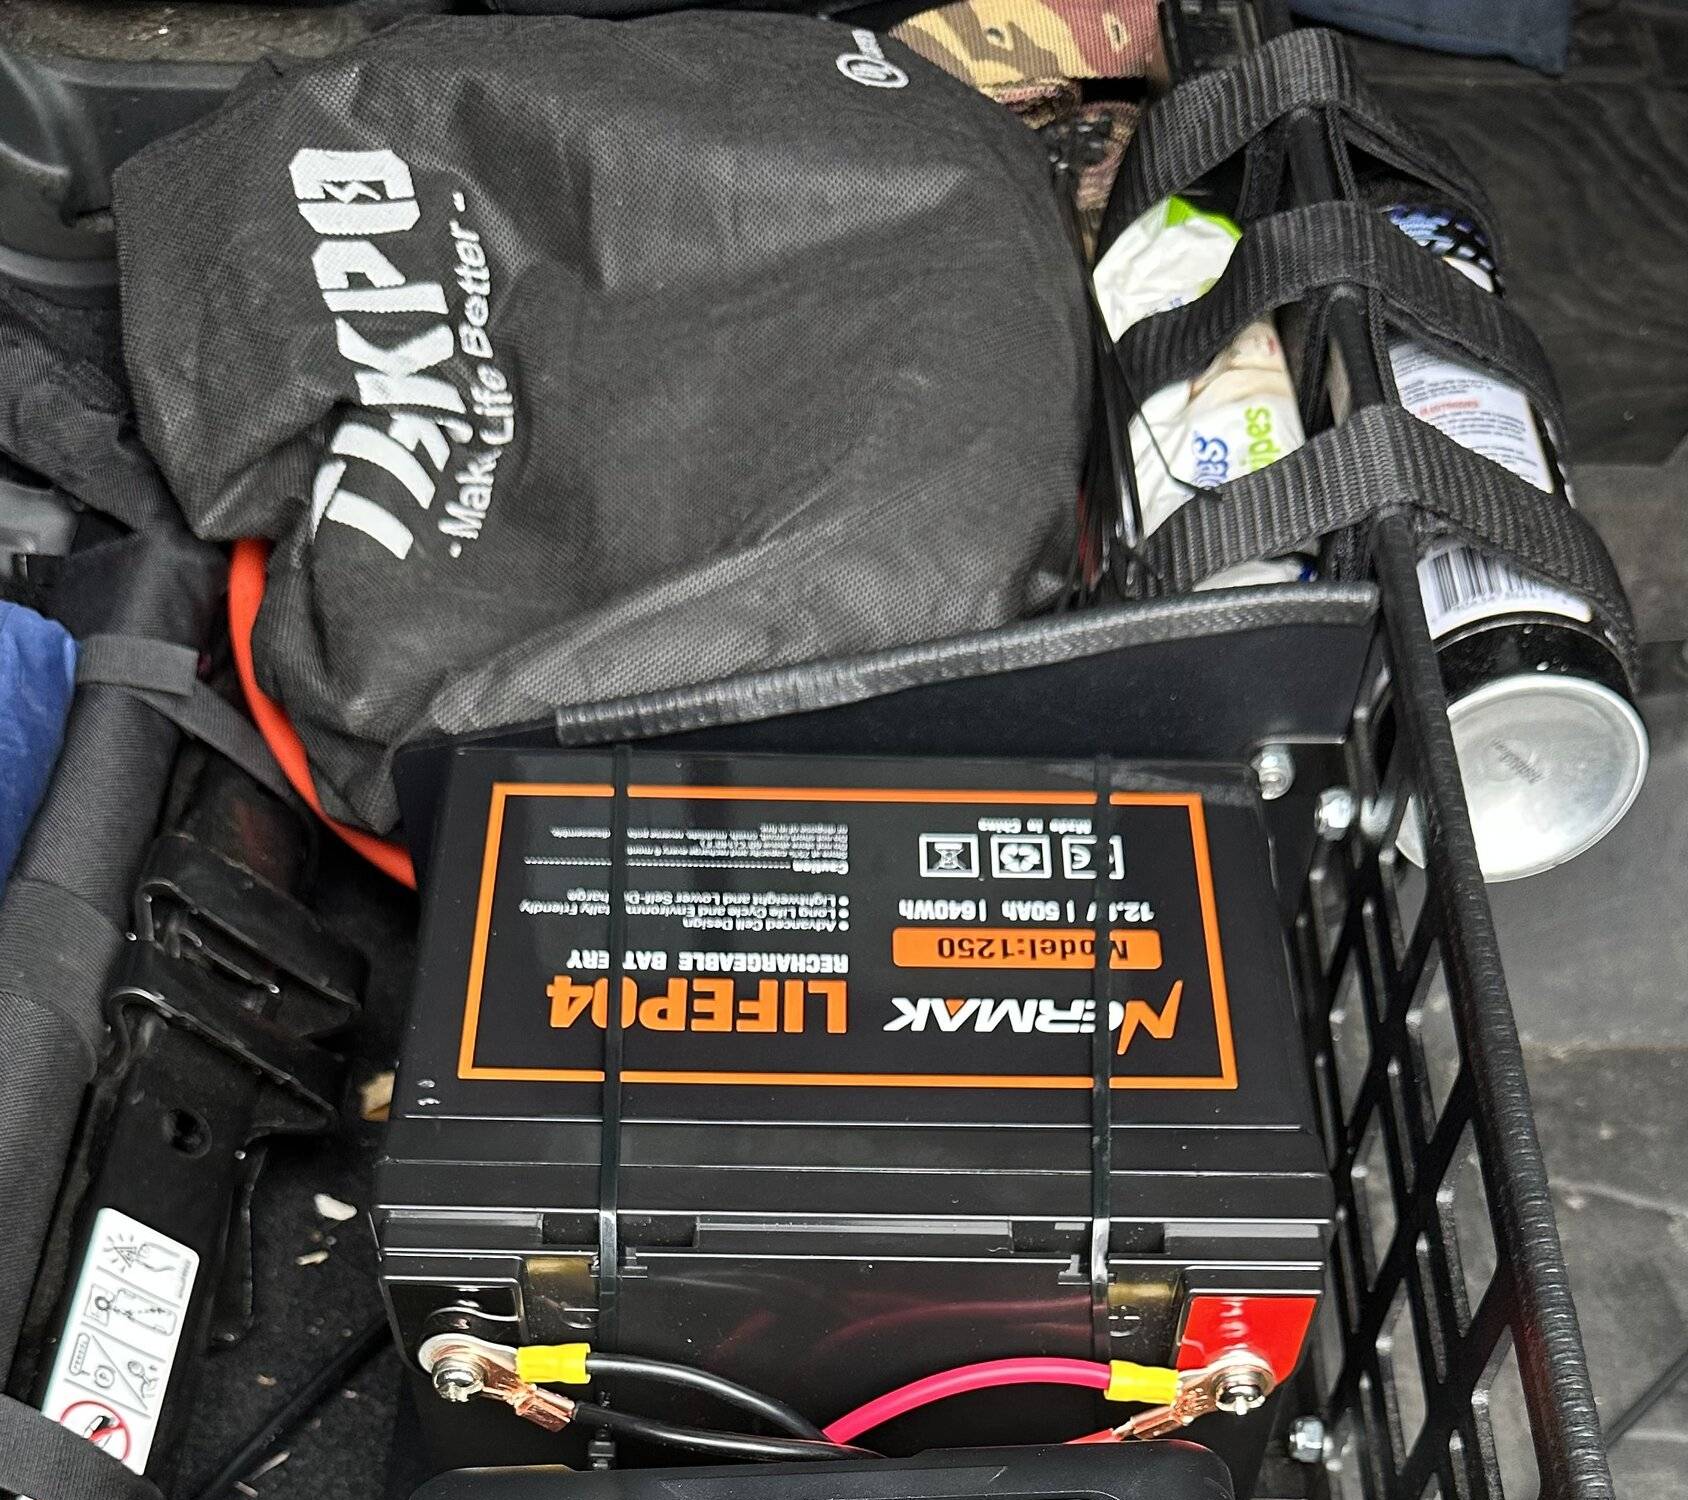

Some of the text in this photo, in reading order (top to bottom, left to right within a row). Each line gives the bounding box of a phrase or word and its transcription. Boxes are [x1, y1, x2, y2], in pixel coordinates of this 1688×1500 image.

[470, 363, 514, 446] Life
[1239, 408, 1281, 469] ipes
[518, 899, 578, 915] Friendly
[579, 901, 695, 918] Environmtally
[697, 904, 726, 917] and
[768, 906, 796, 920] Life
[798, 906, 836, 920] Long
[1001, 899, 1060, 921] 50Ah
[682, 916, 837, 933] Advanced Cell Design
[566, 949, 849, 973] RECHARGEABLE BATERY
